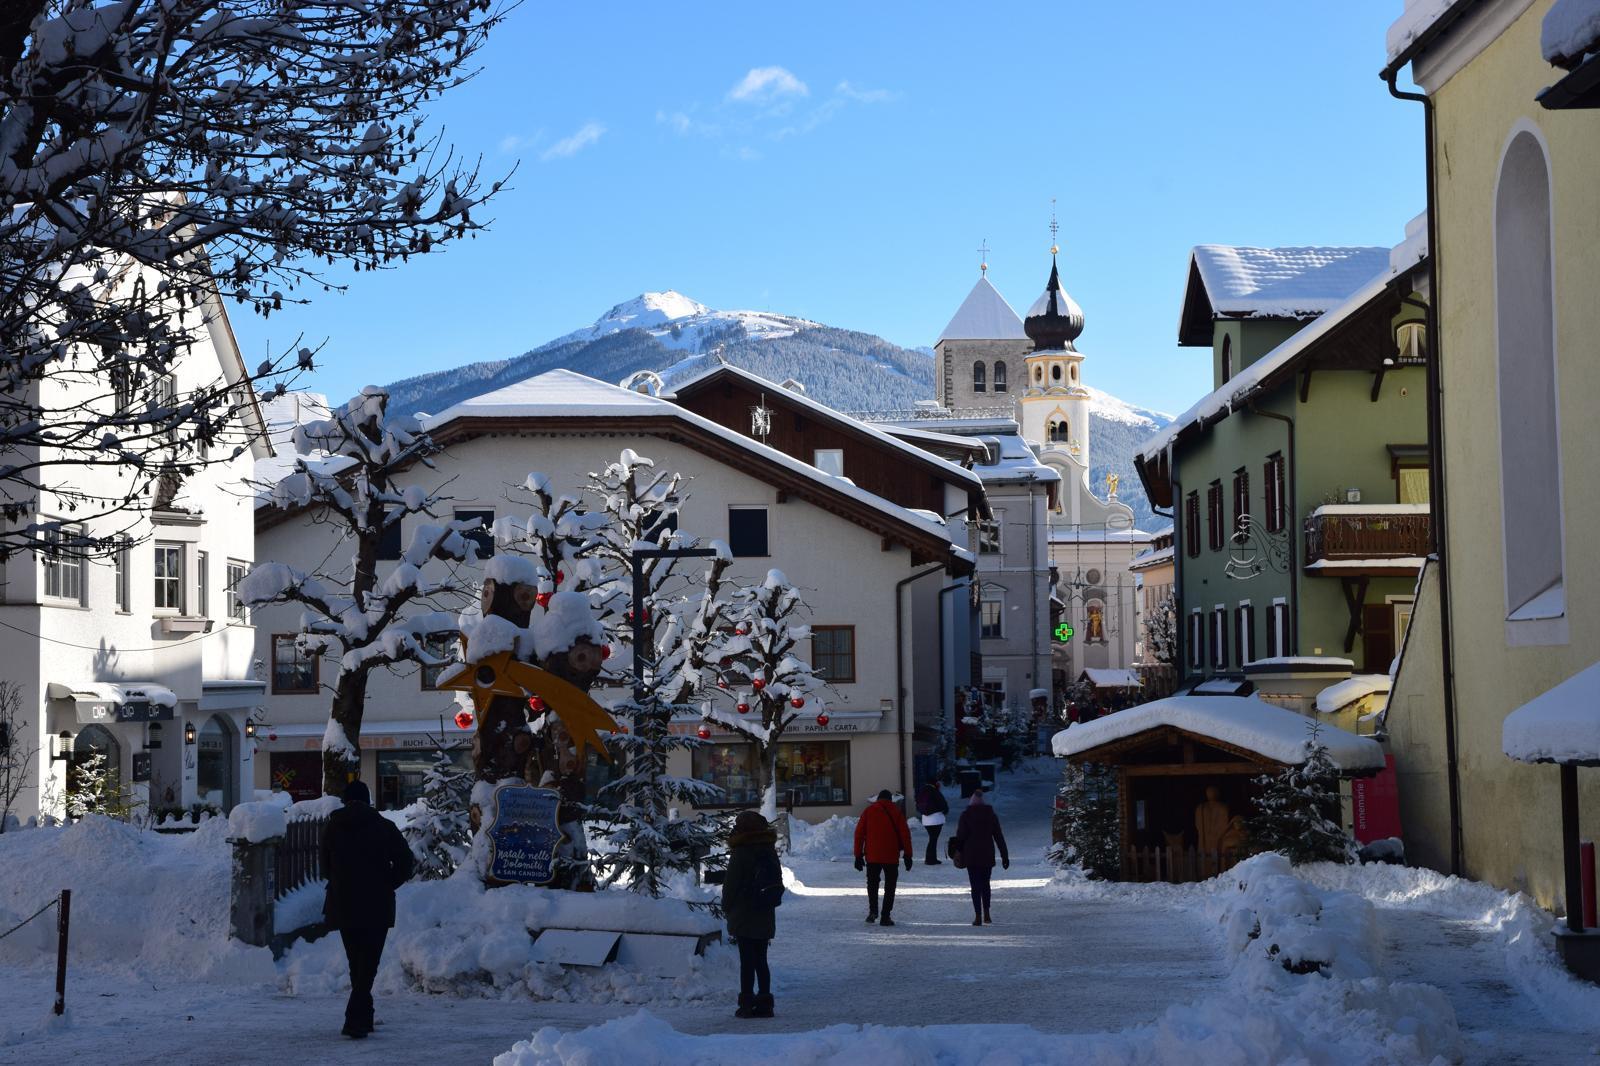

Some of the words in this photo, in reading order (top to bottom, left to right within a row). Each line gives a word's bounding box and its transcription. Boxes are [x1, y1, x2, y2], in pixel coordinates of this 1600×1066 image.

[1357, 783, 1367, 830] annemarie
[498, 850, 526, 860] Natale
[528, 851, 550, 861] nelle
